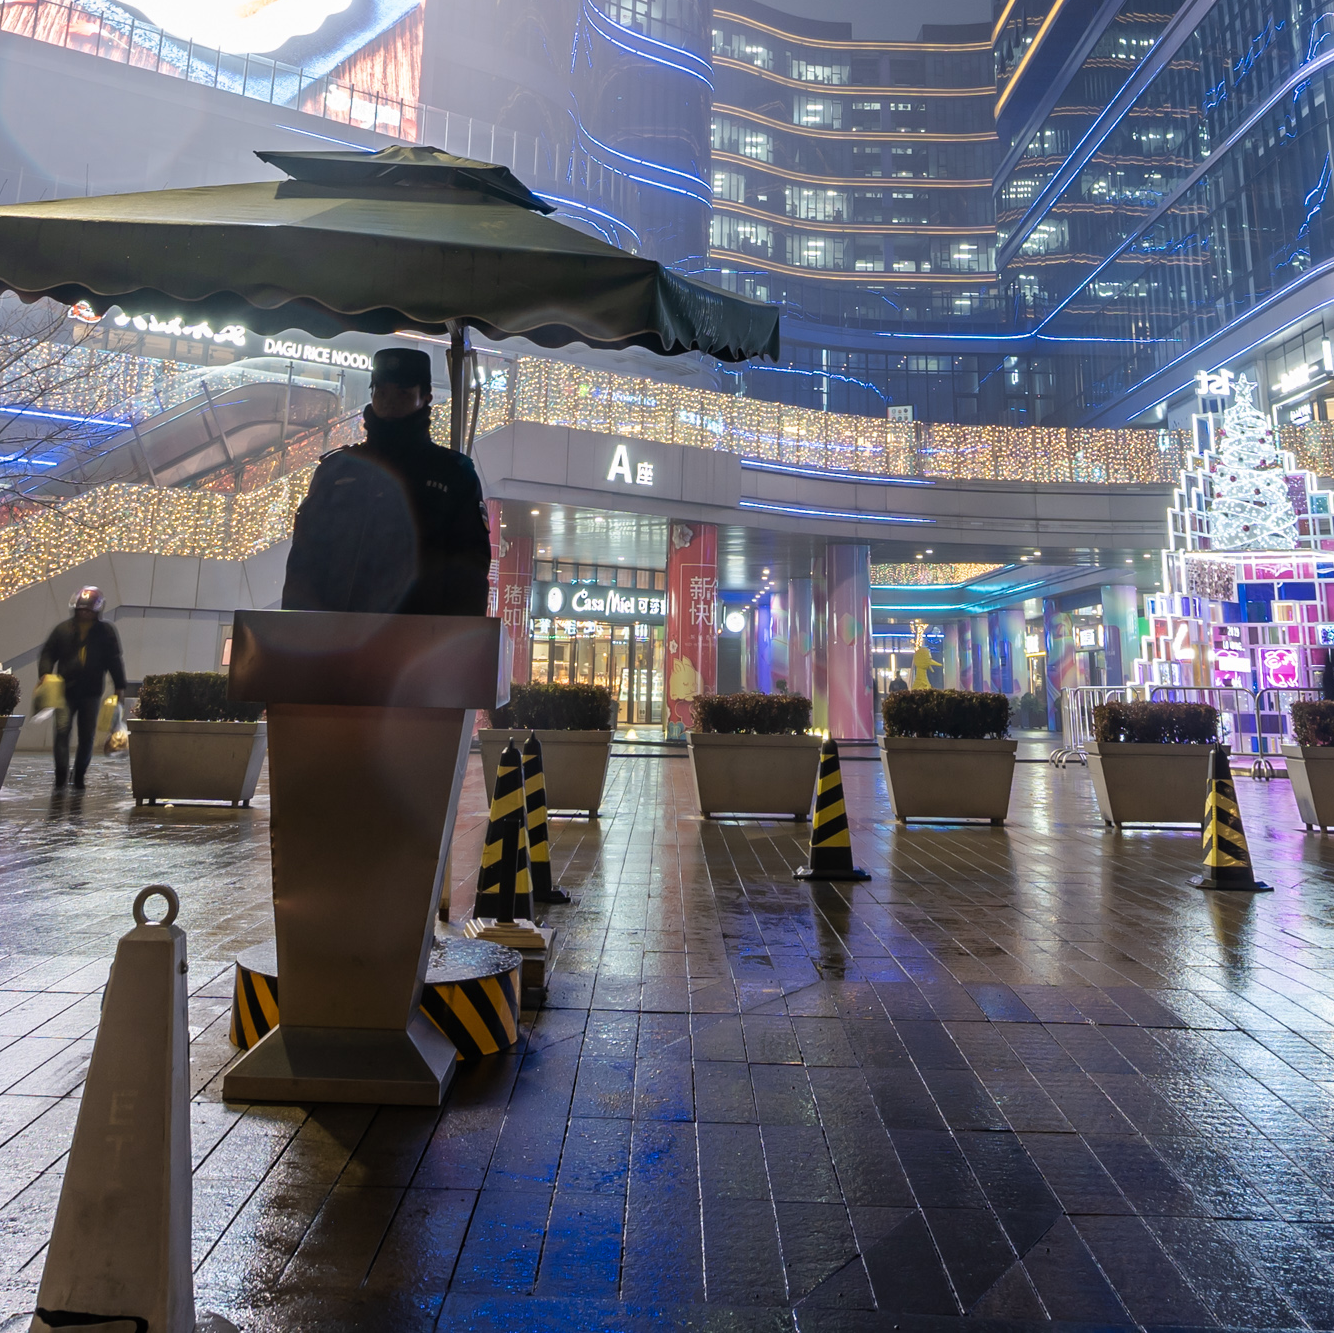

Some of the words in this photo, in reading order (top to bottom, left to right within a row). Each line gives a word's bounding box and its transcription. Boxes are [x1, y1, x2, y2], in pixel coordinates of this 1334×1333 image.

[264, 337, 303, 360] DAGU
[302, 344, 331, 363] RICE
[571, 587, 605, 612] Casa
[605, 589, 635, 617] Miel
